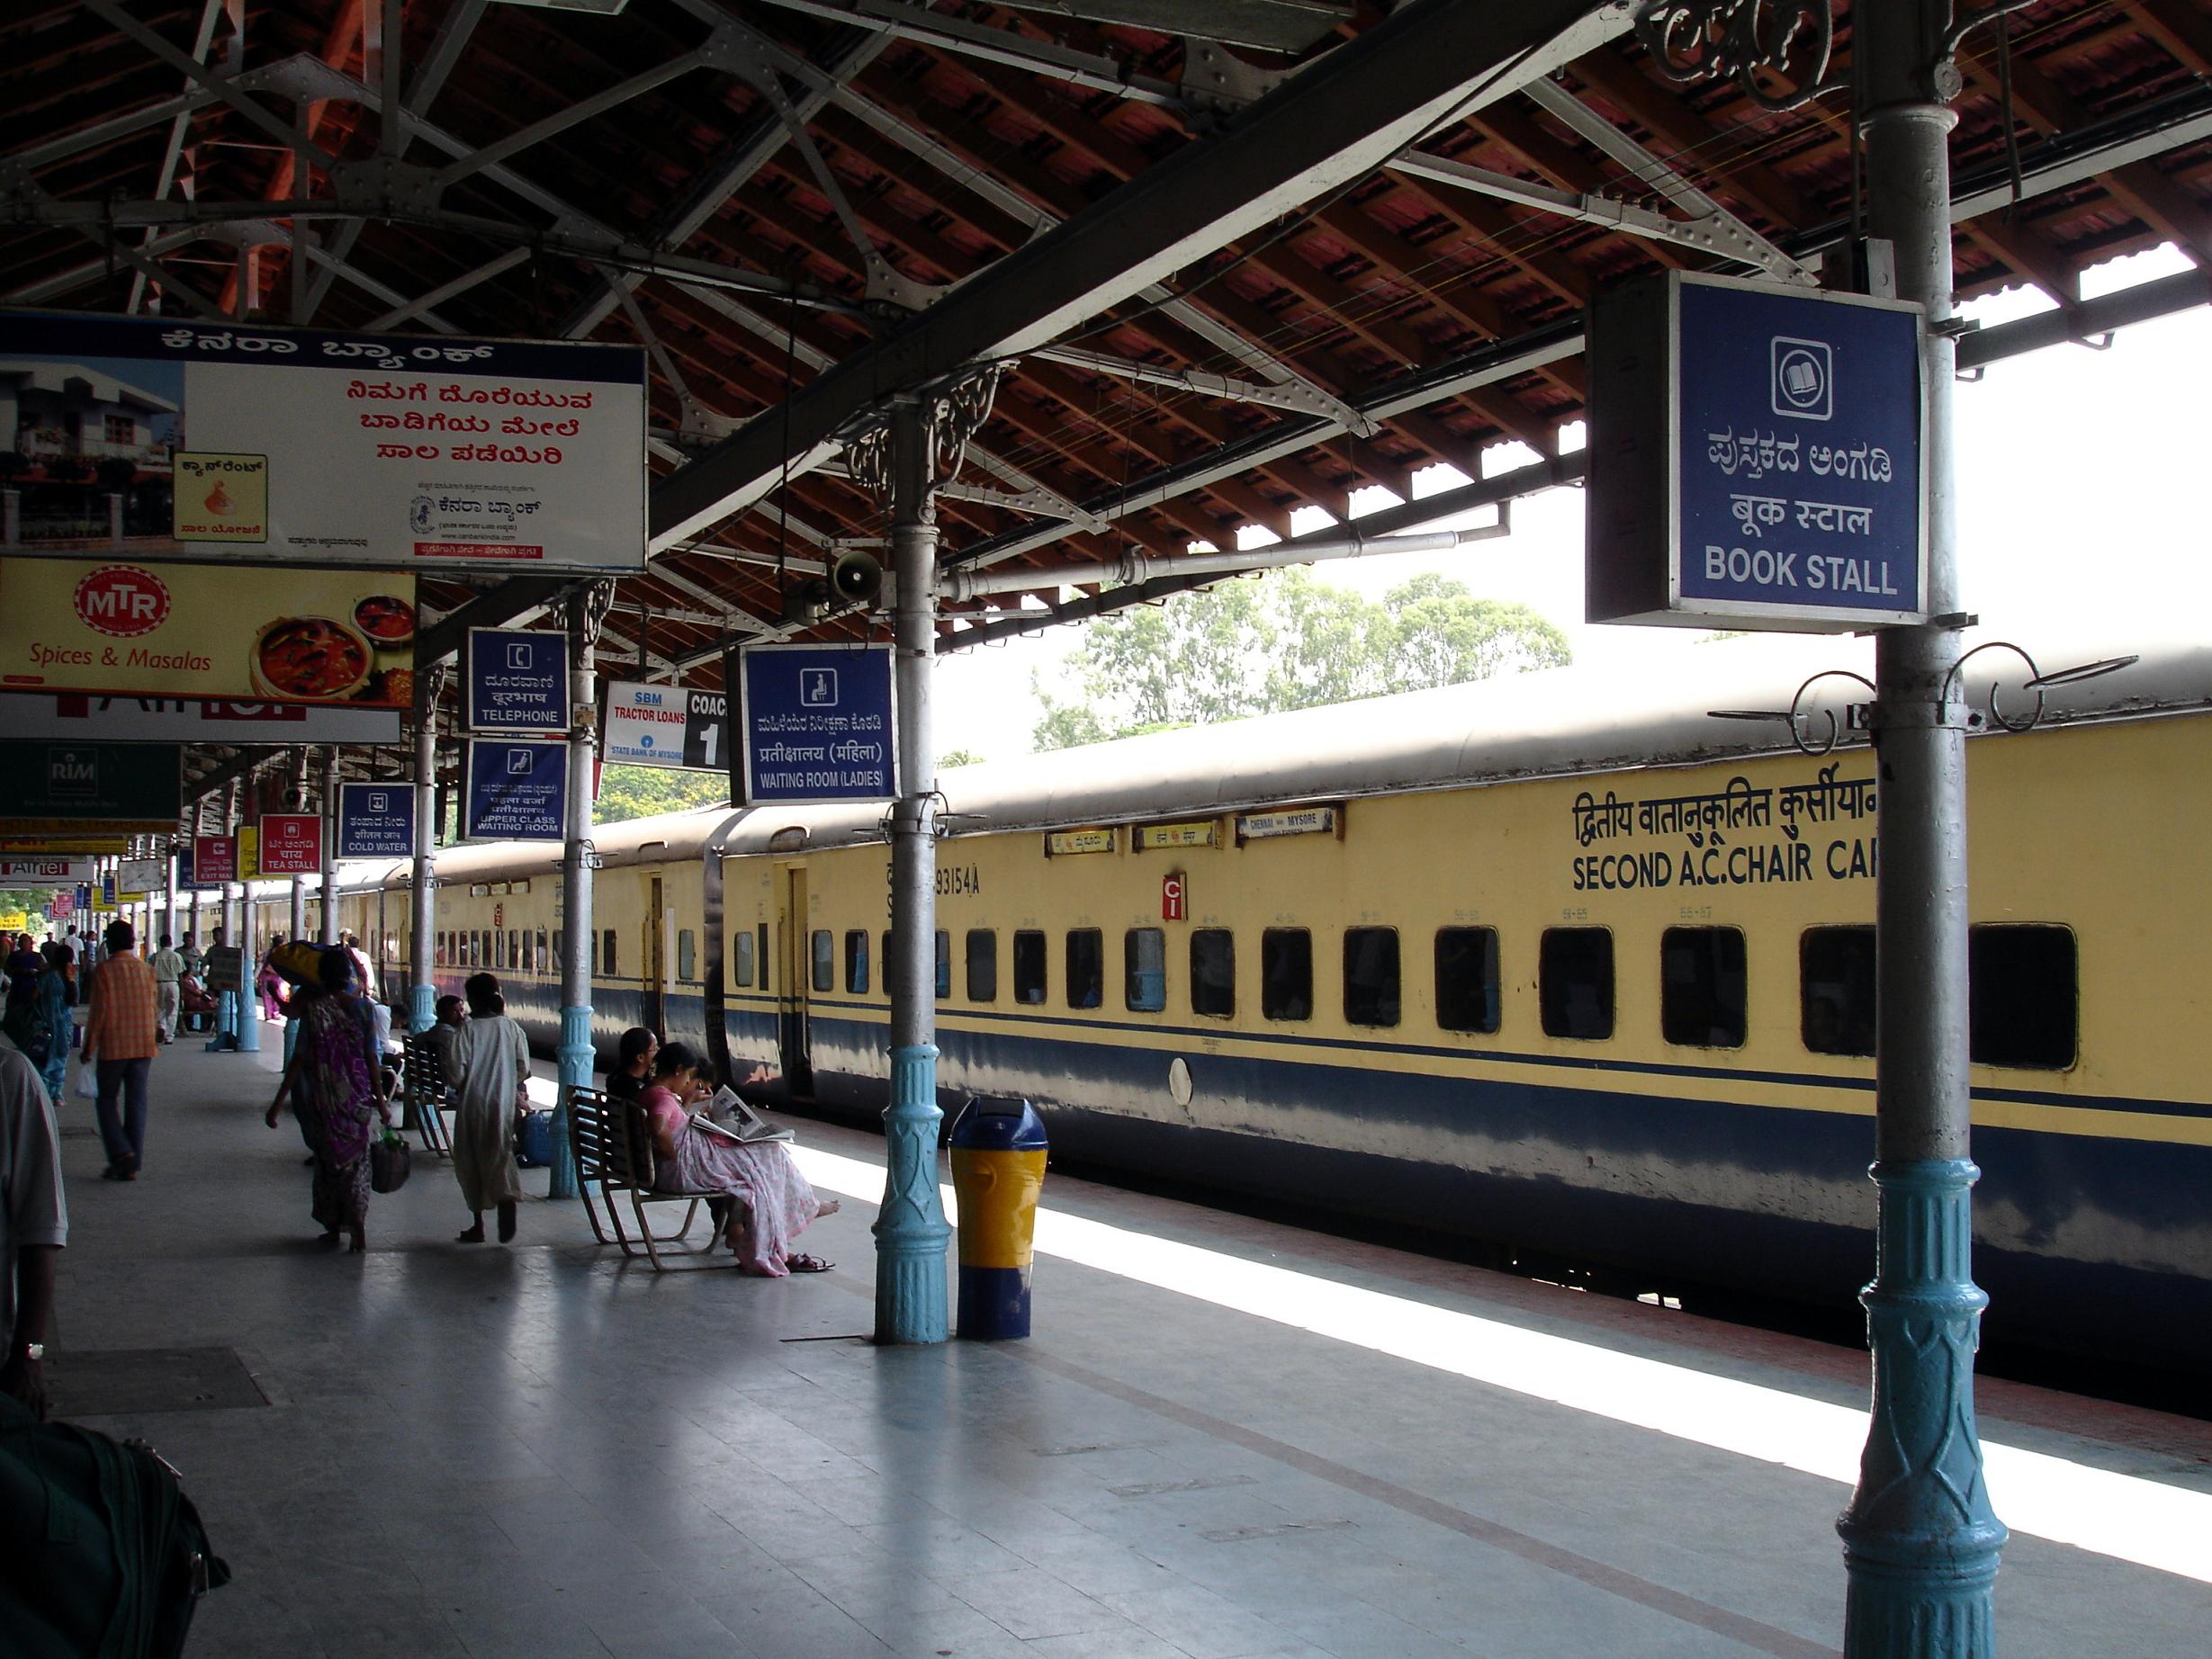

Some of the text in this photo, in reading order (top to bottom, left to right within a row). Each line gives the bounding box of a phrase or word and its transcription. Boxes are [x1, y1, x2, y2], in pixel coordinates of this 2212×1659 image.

[161, 330, 494, 369] ಕೆನರಾ ಬ್ಯಾಂಕ್
[347, 380, 592, 409] ನಿಮಗೆ ದೊರೆಯುವ
[361, 411, 579, 436] ಬಾಡಿಗೆಯ ಮೇಲೆ
[377, 444, 562, 464] ಸಾಲ ಪಡೆಯಿರಿ
[1708, 425, 1892, 482] ಪುಸ್ತಕದ ಅಂಗಡಿ
[439, 497, 541, 521] ಕೆನರಾ ಬ್ಯಾಂಕ್
[1730, 494, 1873, 538] बूक स्टाल
[1705, 545, 1898, 595] BOOK STALL
[86, 583, 157, 620] MTR
[30, 643, 211, 671] Spices & Masalas
[491, 692, 547, 705] दूरभाष
[634, 692, 662, 704] SBM
[691, 695, 727, 716] COAC
[482, 709, 558, 722] TELEPHONE
[615, 706, 685, 724] TRACTOR LOANS
[612, 746, 629, 754] STATE
[631, 748, 648, 757] BANK
[658, 750, 682, 759] MYSORE
[700, 723, 718, 765] 1
[760, 740, 882, 764] प्रतीक्षालय (महिला)
[760, 770, 883, 788] WAITING ROOM (LADIES)
[519, 816, 555, 824] CLASS
[1288, 813, 1317, 826] MYSORE
[1572, 792, 1634, 847] द्वितीय
[1639, 776, 1773, 848] वातानुकूलित
[478, 823, 558, 831] WAITING ROOM
[280, 850, 302, 858] चाय
[348, 843, 407, 851] COLD WATER
[267, 860, 315, 869] TEA STALL
[1573, 851, 1672, 891] SECOND
